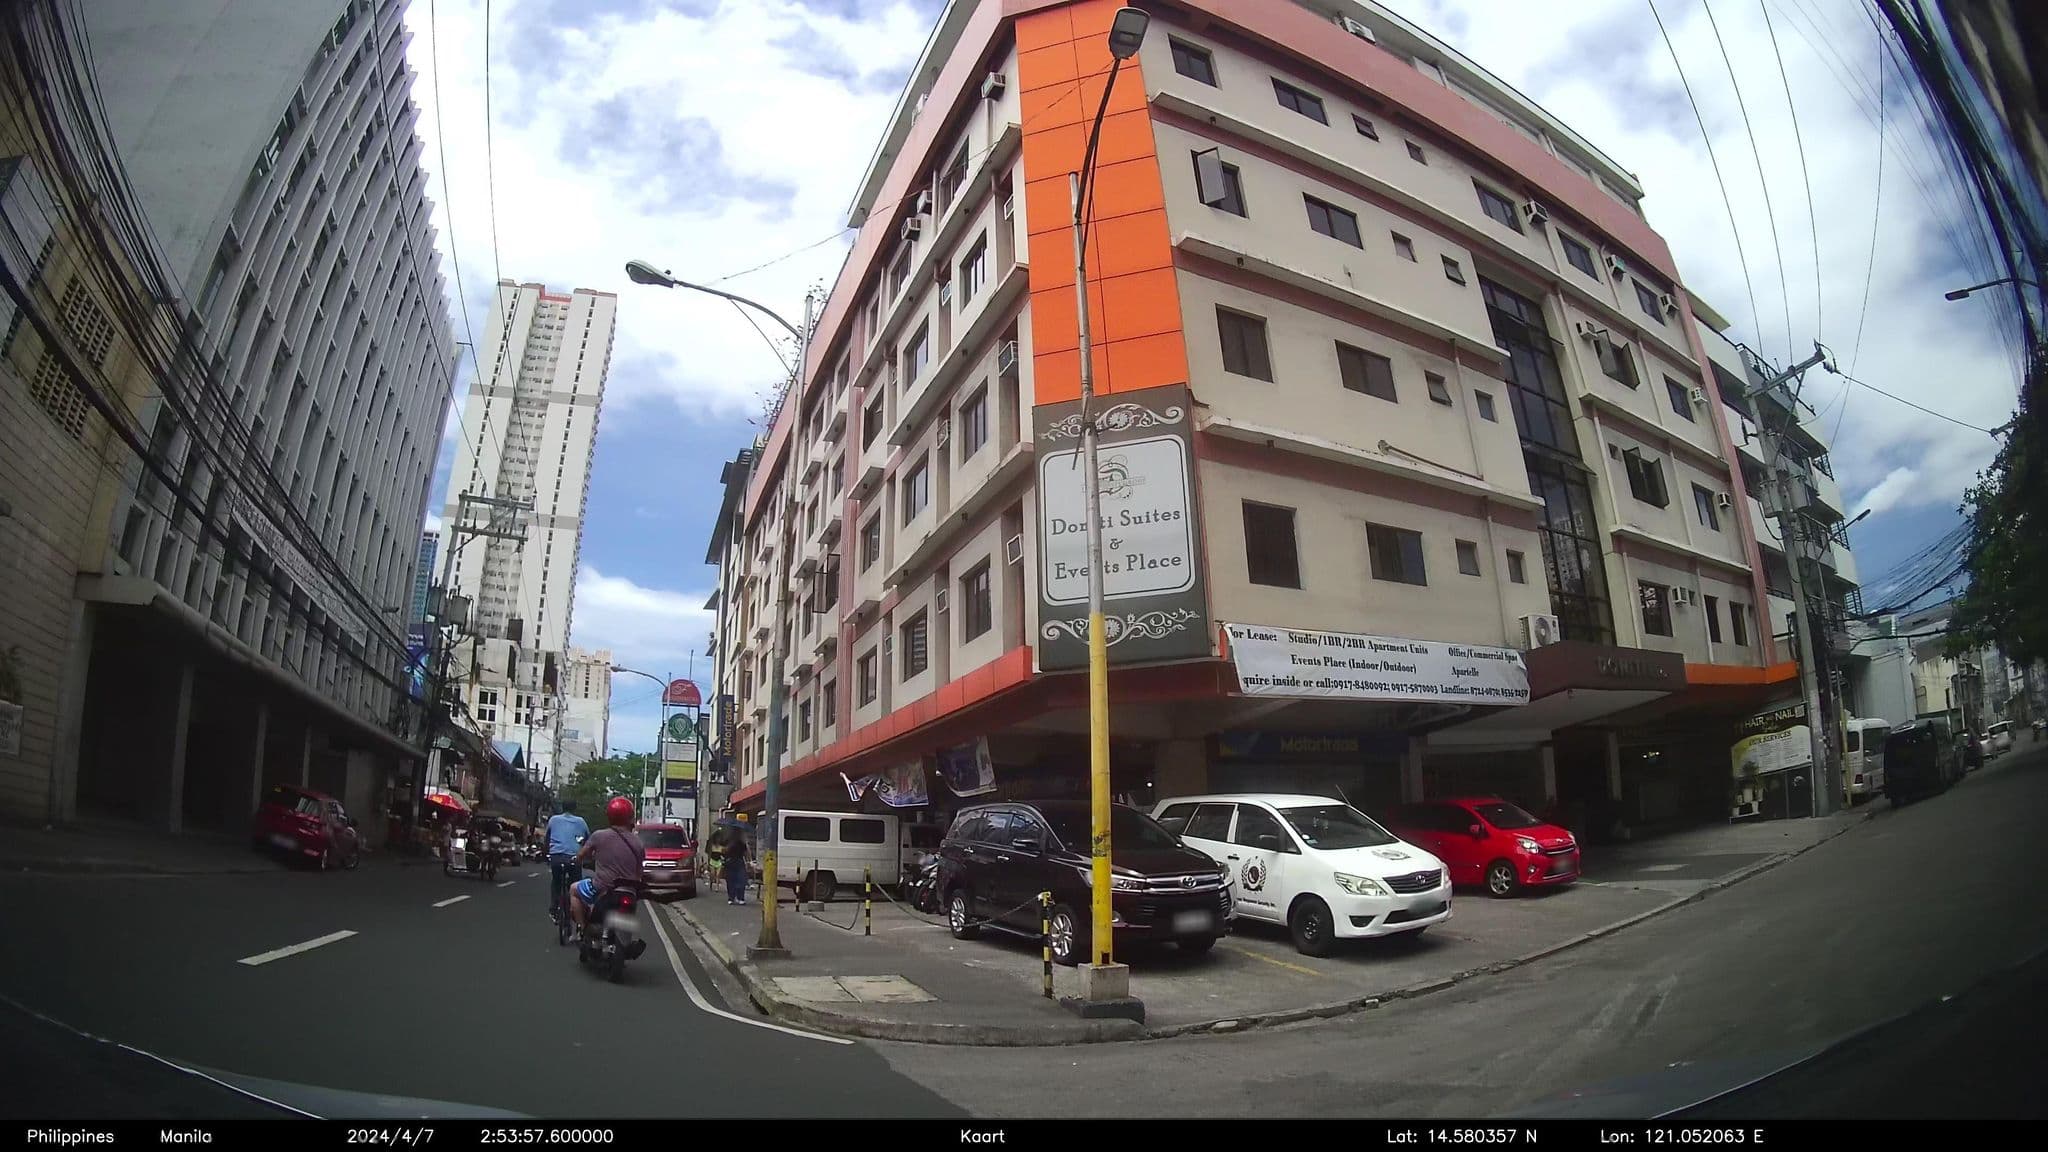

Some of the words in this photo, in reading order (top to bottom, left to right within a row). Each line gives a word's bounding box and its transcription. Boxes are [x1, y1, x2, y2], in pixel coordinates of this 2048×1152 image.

[1120, 508, 1181, 527] Suites
[1109, 538, 1124, 550] &
[1055, 560, 1119, 580] Evets
[1126, 553, 1182, 572] Place
[1229, 626, 1244, 639] or
[1247, 628, 1278, 642] Lease:
[1288, 632, 1366, 650] Studio/1BR/2BR
[1368, 640, 1408, 654] Apartment
[1409, 643, 1429, 655] Units
[1448, 647, 1504, 662] Office/Commercial
[1290, 654, 1322, 667] Events
[1323, 656, 1347, 668] Place
[1348, 658, 1417, 674] (Indoor/Outdoor)
[1451, 666, 1480, 678] Apartelle
[1272, 675, 1300, 688] inside
[1303, 679, 1314, 688] or
[1440, 684, 1470, 695] Landline:
[723, 701, 733, 756] Motortrade
[1744, 716, 1764, 728] HAIR
[1775, 708, 1795, 721] NAIL
